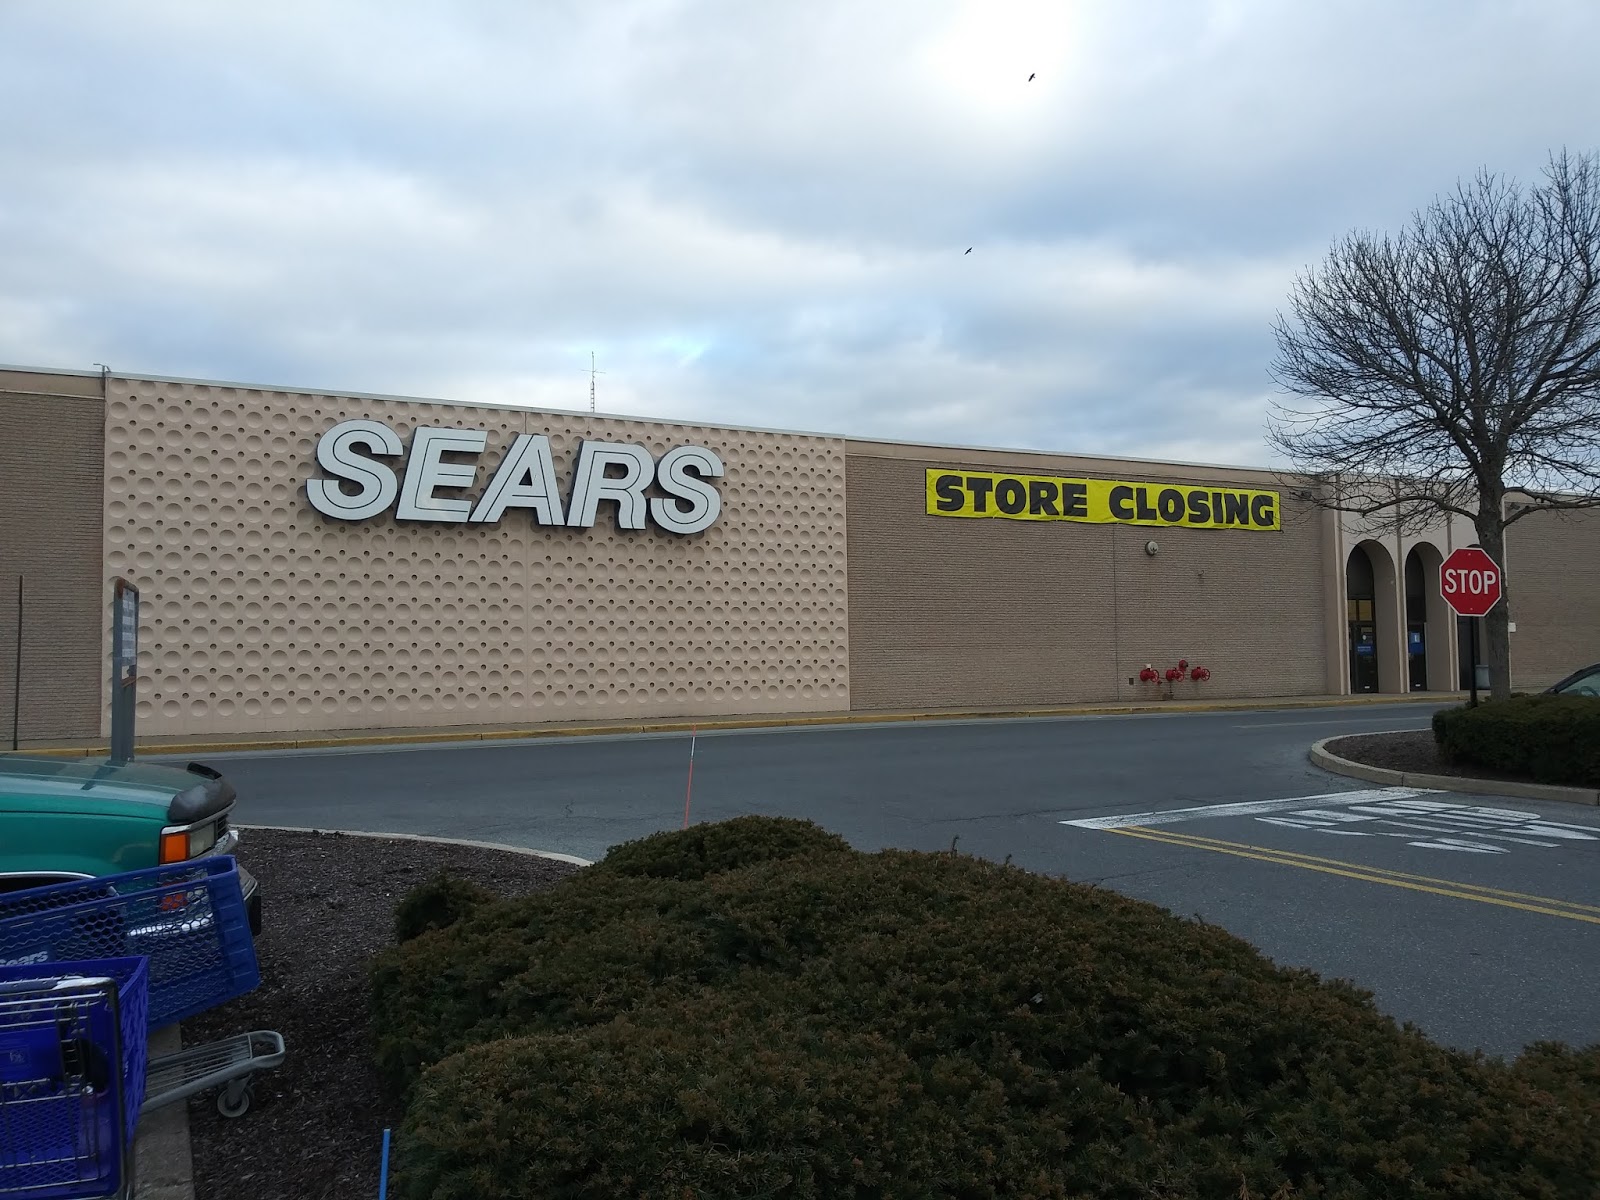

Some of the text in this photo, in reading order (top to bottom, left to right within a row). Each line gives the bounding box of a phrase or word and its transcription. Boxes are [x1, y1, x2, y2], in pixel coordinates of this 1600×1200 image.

[306, 418, 725, 536] SEARS
[935, 475, 1275, 527] STORE CLOSING
[1444, 568, 1497, 596] STOP
[1254, 800, 1600, 855] STOP
